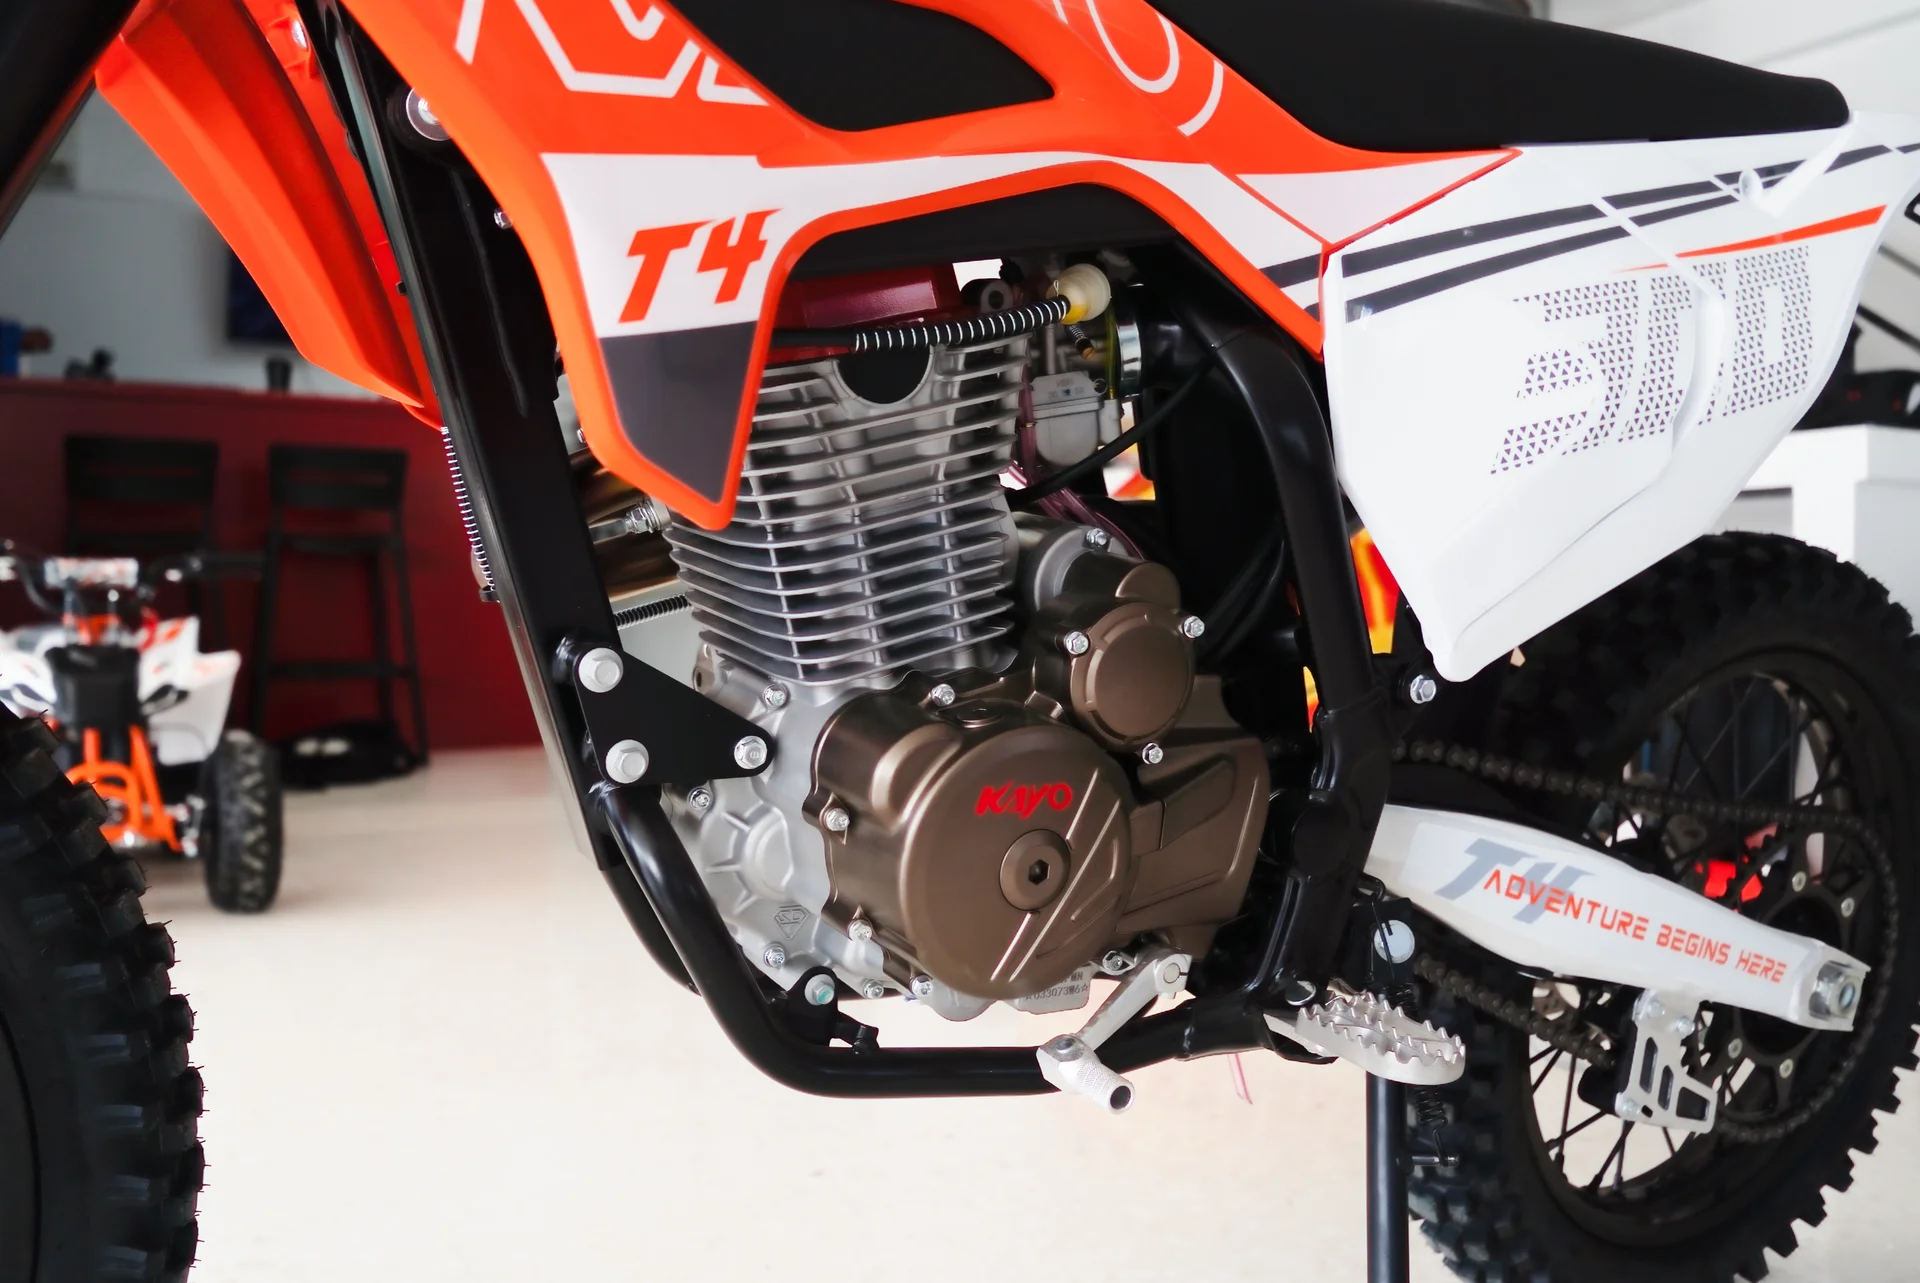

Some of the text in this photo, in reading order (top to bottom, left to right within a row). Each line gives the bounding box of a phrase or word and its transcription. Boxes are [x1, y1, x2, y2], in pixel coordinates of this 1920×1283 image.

[618, 207, 784, 324] T4
[975, 778, 1073, 820] KAYO
[1484, 868, 1789, 984] ADVENTURE BEGINS HERE
